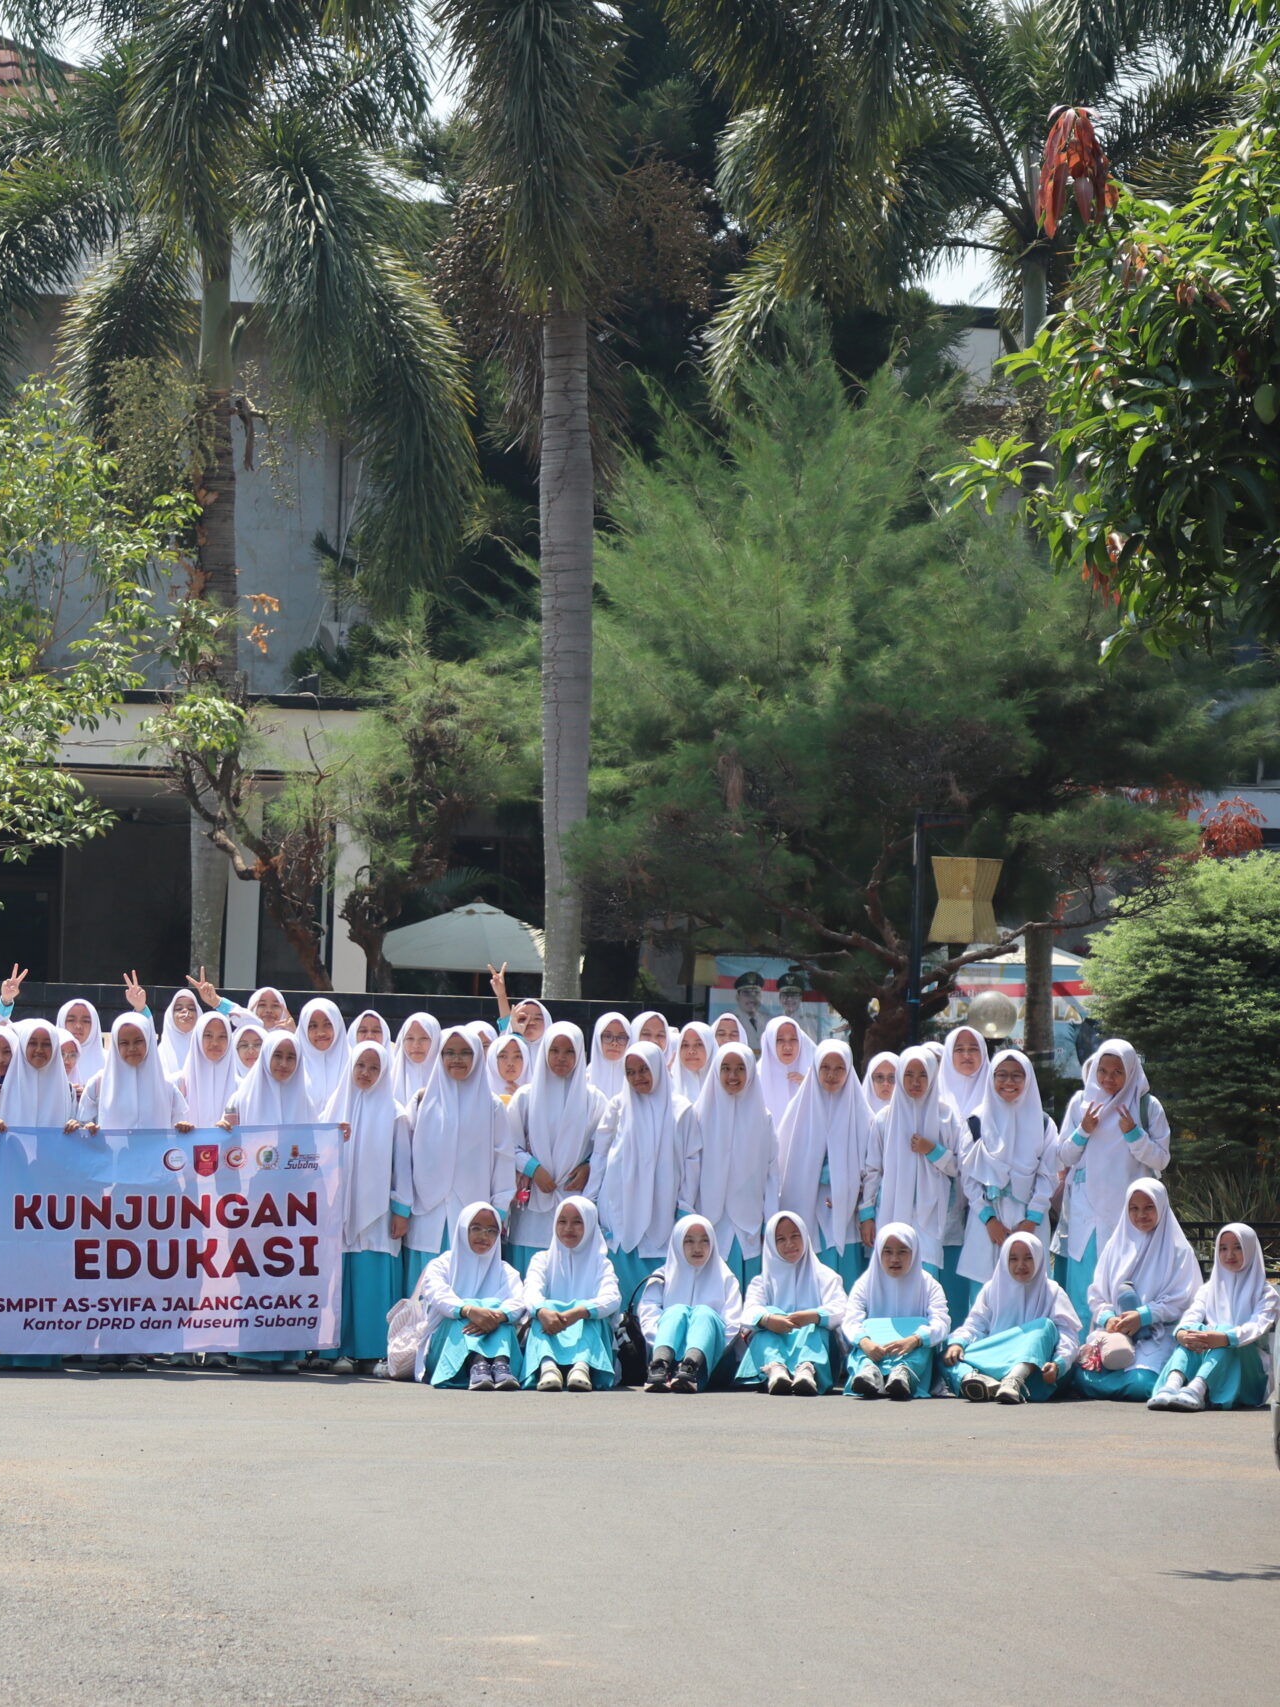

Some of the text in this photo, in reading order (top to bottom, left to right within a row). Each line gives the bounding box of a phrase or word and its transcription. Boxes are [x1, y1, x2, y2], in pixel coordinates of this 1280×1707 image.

[14, 1191, 318, 1231] KUNJUNGAN
[74, 1235, 320, 1280] EDUKASI
[62, 1297, 157, 1312] AS-SYIFA
[162, 1294, 303, 1311] JALANCAGAK
[308, 1294, 320, 1308] 2
[23, 1314, 318, 1330] Kantor DPRD dan Museum Subang
